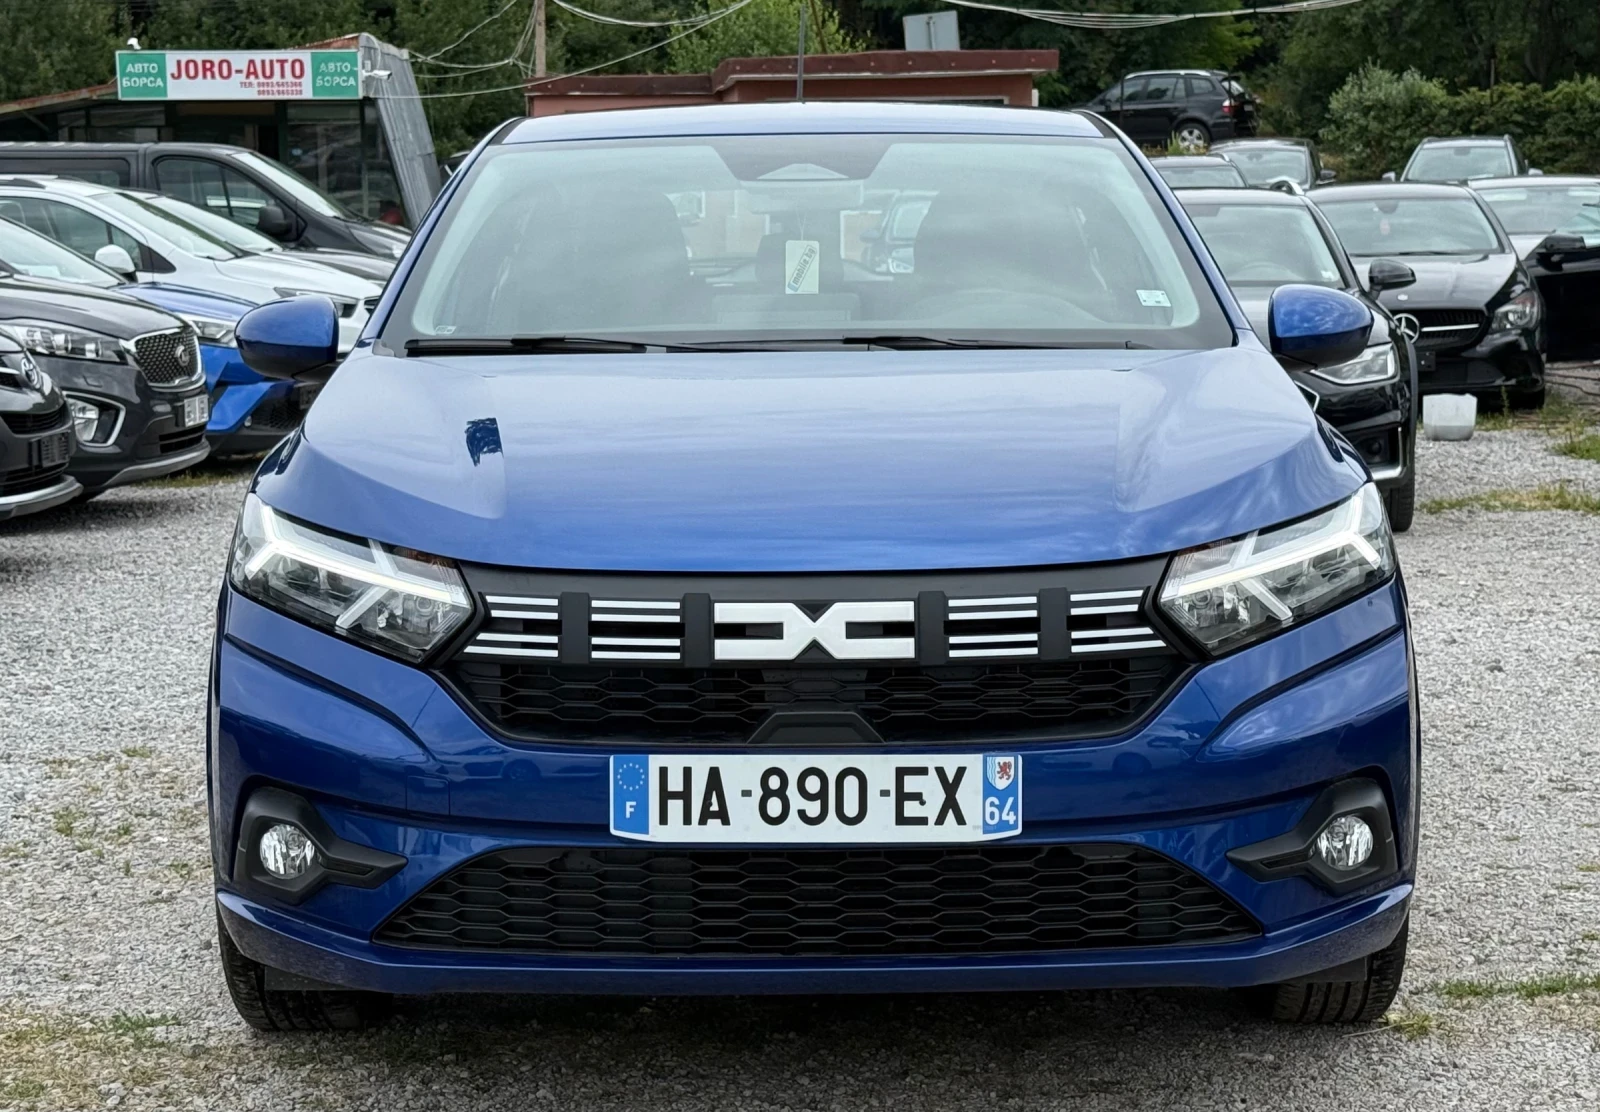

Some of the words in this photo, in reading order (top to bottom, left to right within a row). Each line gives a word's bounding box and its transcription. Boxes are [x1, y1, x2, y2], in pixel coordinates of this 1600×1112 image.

[126, 63, 159, 74] АВТО
[170, 58, 306, 81] JORO-AUTO
[319, 62, 351, 73] АВТО
[122, 77, 164, 88] БОРСА
[315, 76, 356, 87] БОРСА
[792, 248, 816, 285] mobile.bg
[625, 801, 637, 818] F
[984, 796, 1017, 826] 64
